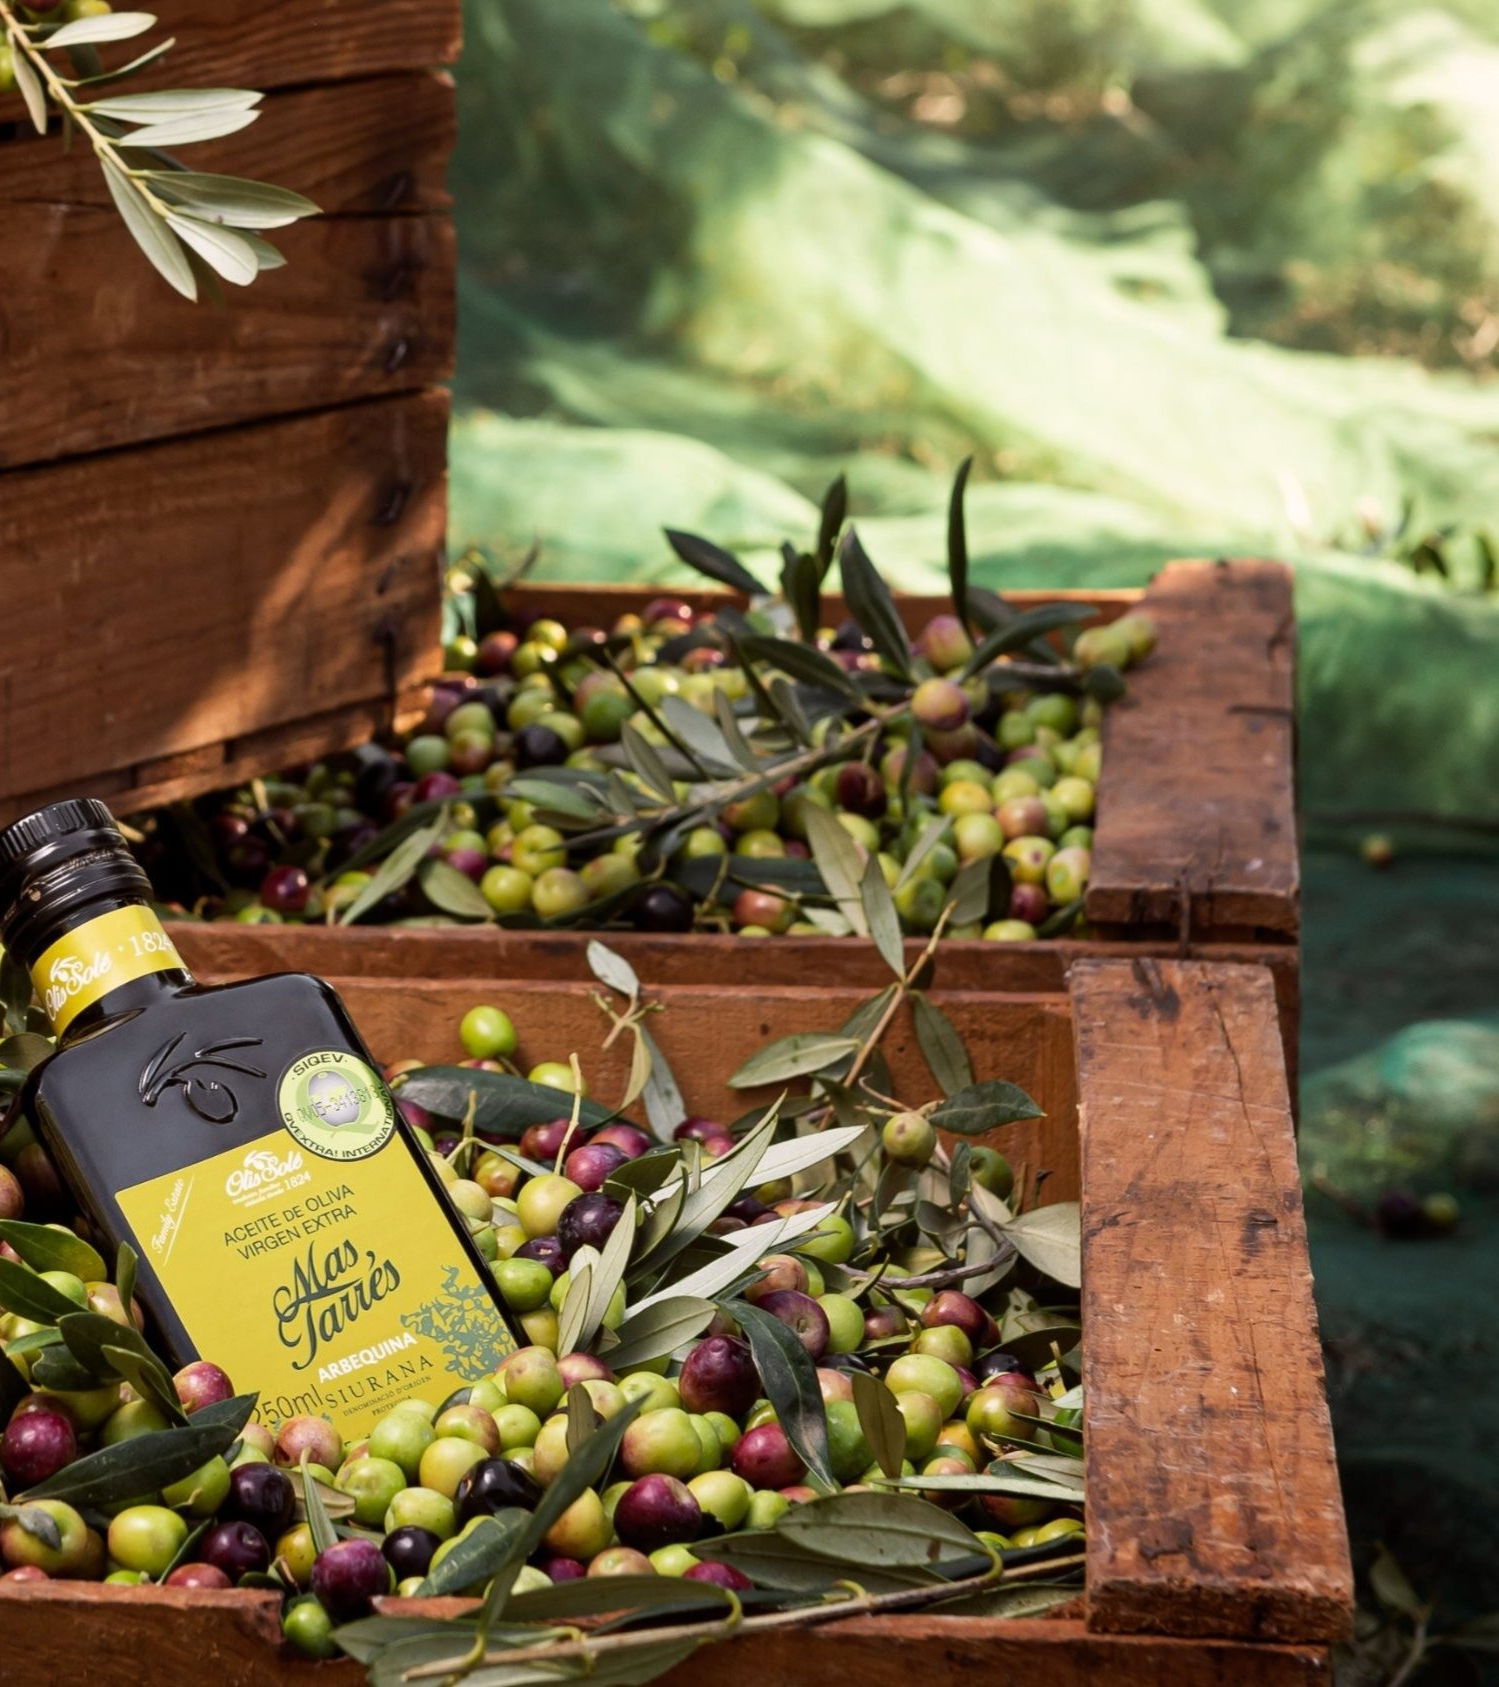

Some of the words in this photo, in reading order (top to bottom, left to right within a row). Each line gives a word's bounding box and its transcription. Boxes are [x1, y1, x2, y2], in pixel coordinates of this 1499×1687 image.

[293, 1053, 344, 1076] SIQEV
[284, 1112, 338, 1158] QVEXTRA!
[284, 1170, 312, 1191] 1824
[223, 1213, 282, 1247] ACEITE
[282, 1206, 304, 1222] DE
[304, 1184, 355, 1212] OLIVA
[236, 1228, 302, 1260] VIRGEN
[301, 1204, 358, 1235] EXTRA
[273, 1239, 362, 1323] Mas
[317, 1331, 418, 1383] ARBEQUINA
[324, 1354, 434, 1410] SIURANA
